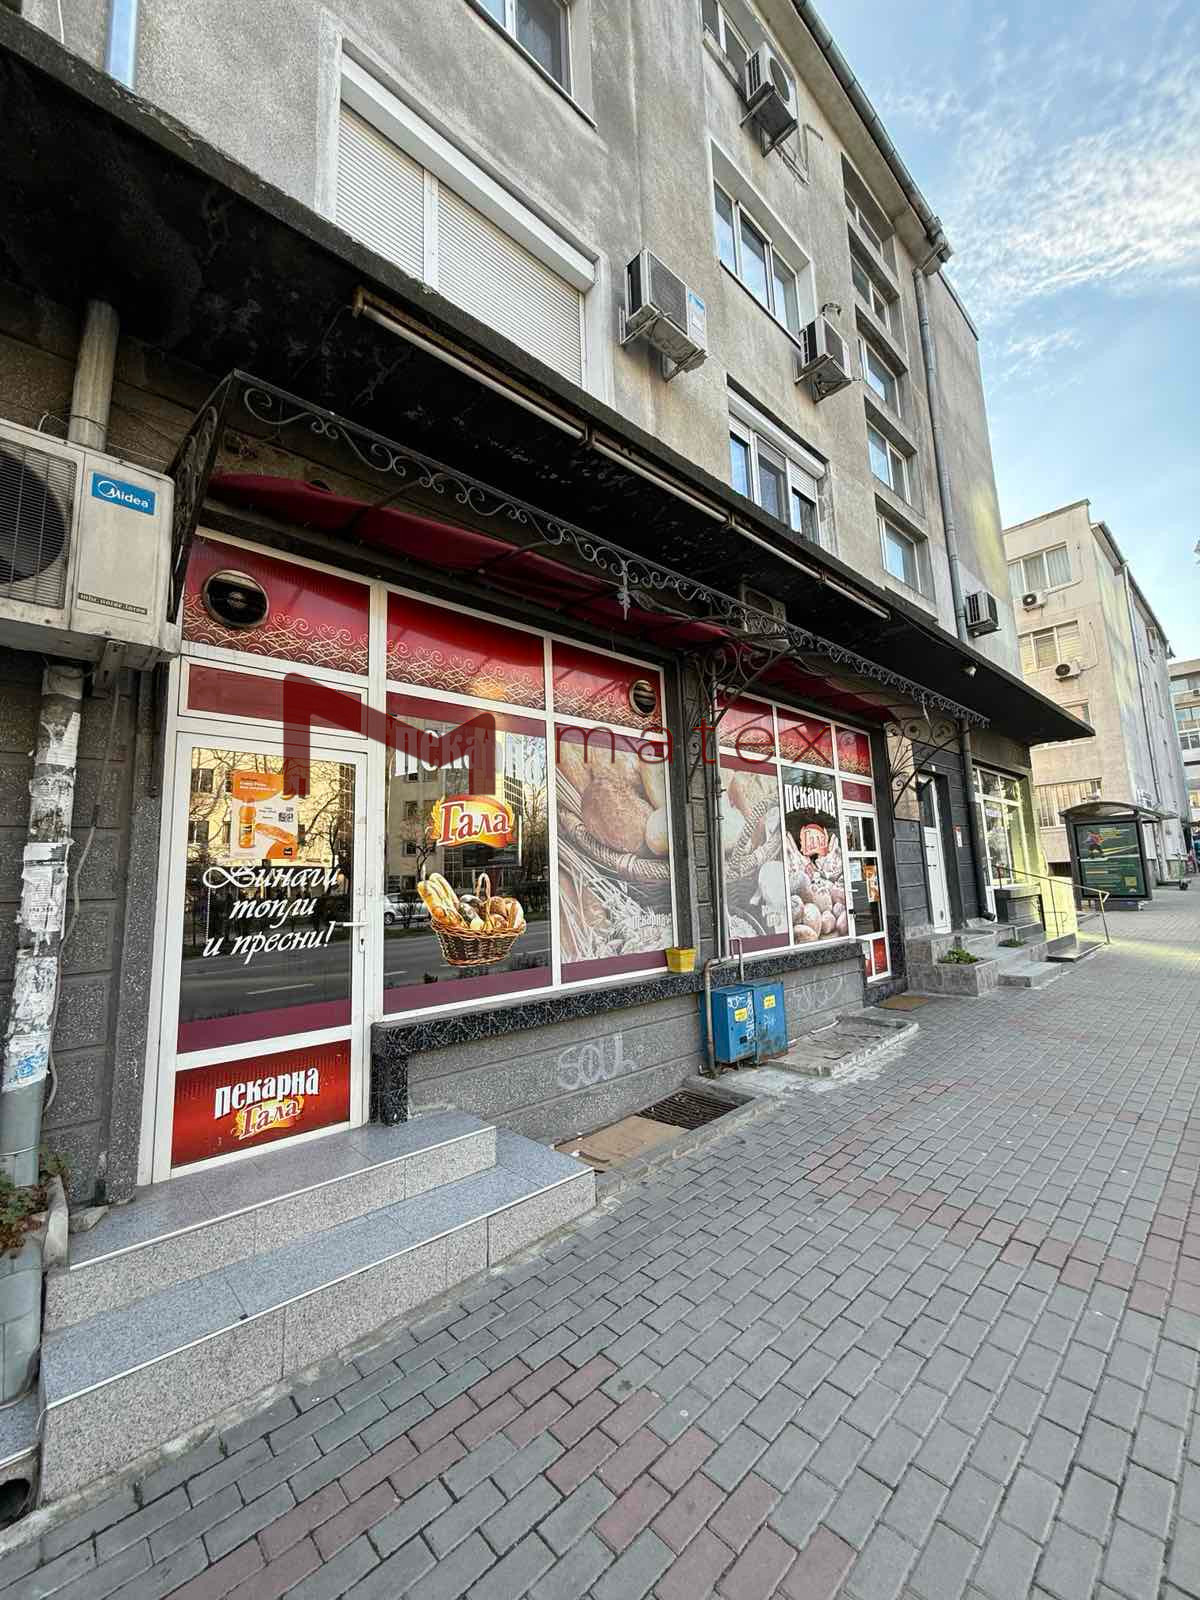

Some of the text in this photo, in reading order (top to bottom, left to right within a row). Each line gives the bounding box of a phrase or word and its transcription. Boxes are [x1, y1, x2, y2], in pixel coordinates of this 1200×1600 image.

[100, 484, 149, 508] Midea
[784, 784, 837, 819] пекарна
[436, 801, 511, 846] Гала
[203, 866, 340, 891] Винаги
[229, 898, 317, 929] топли
[202, 920, 337, 965] и пресни!
[214, 1067, 319, 1120] пекарна
[239, 1100, 300, 1140] Гала
